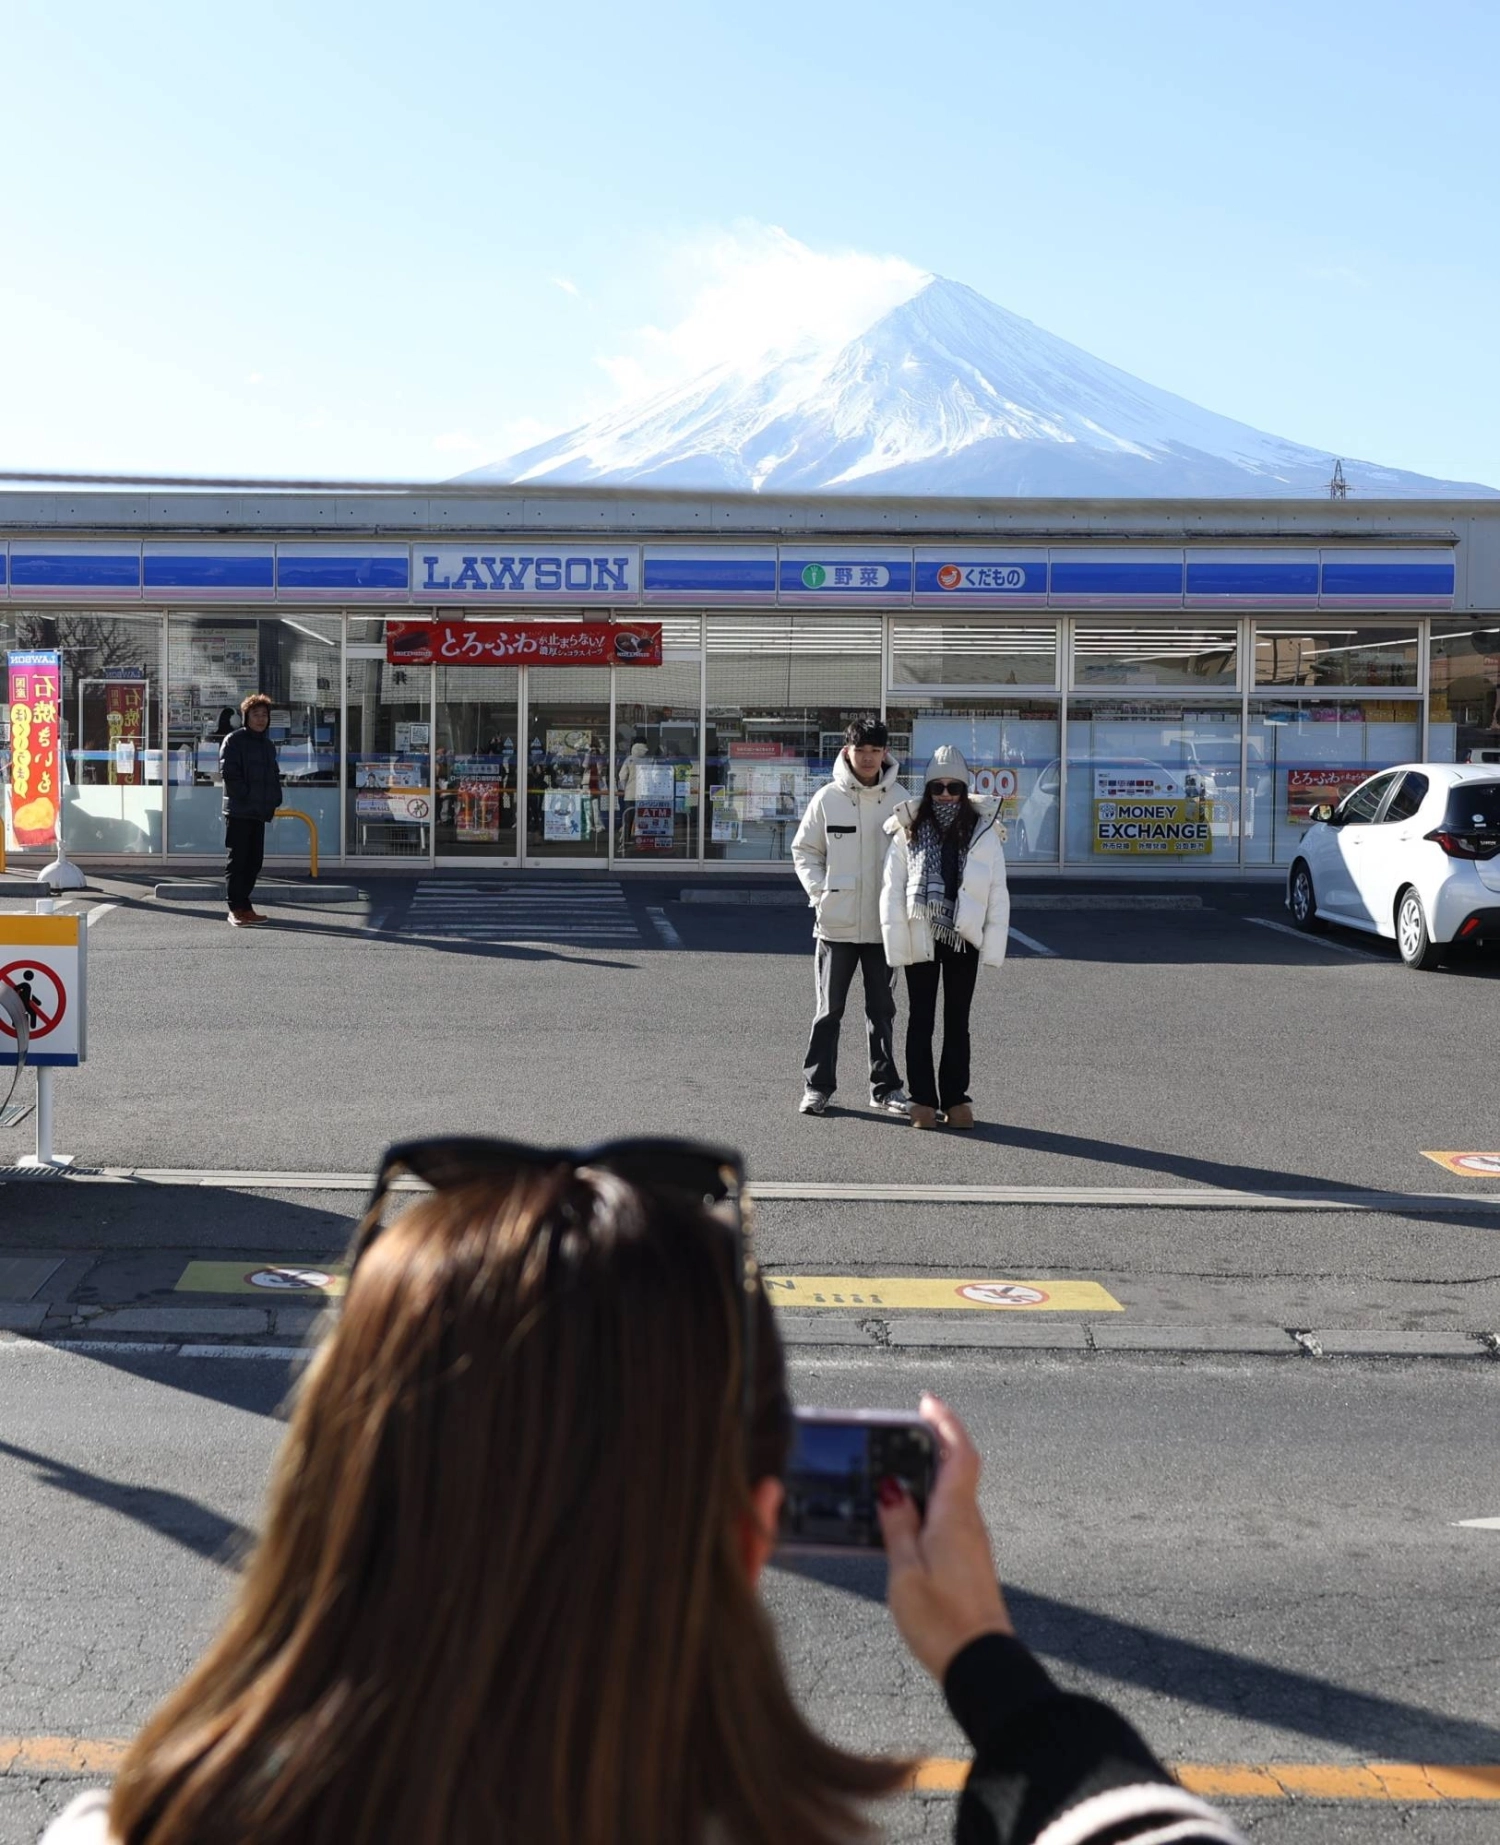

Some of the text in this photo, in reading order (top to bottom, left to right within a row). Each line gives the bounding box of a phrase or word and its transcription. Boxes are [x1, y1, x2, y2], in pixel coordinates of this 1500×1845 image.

[423, 556, 629, 590] LAWSON
[834, 567, 879, 586] 野菜
[965, 568, 1021, 587] くだもの
[643, 808, 667, 817] ATM
[1118, 806, 1177, 819] MONEY
[1098, 824, 1208, 839] EXCHANGE
